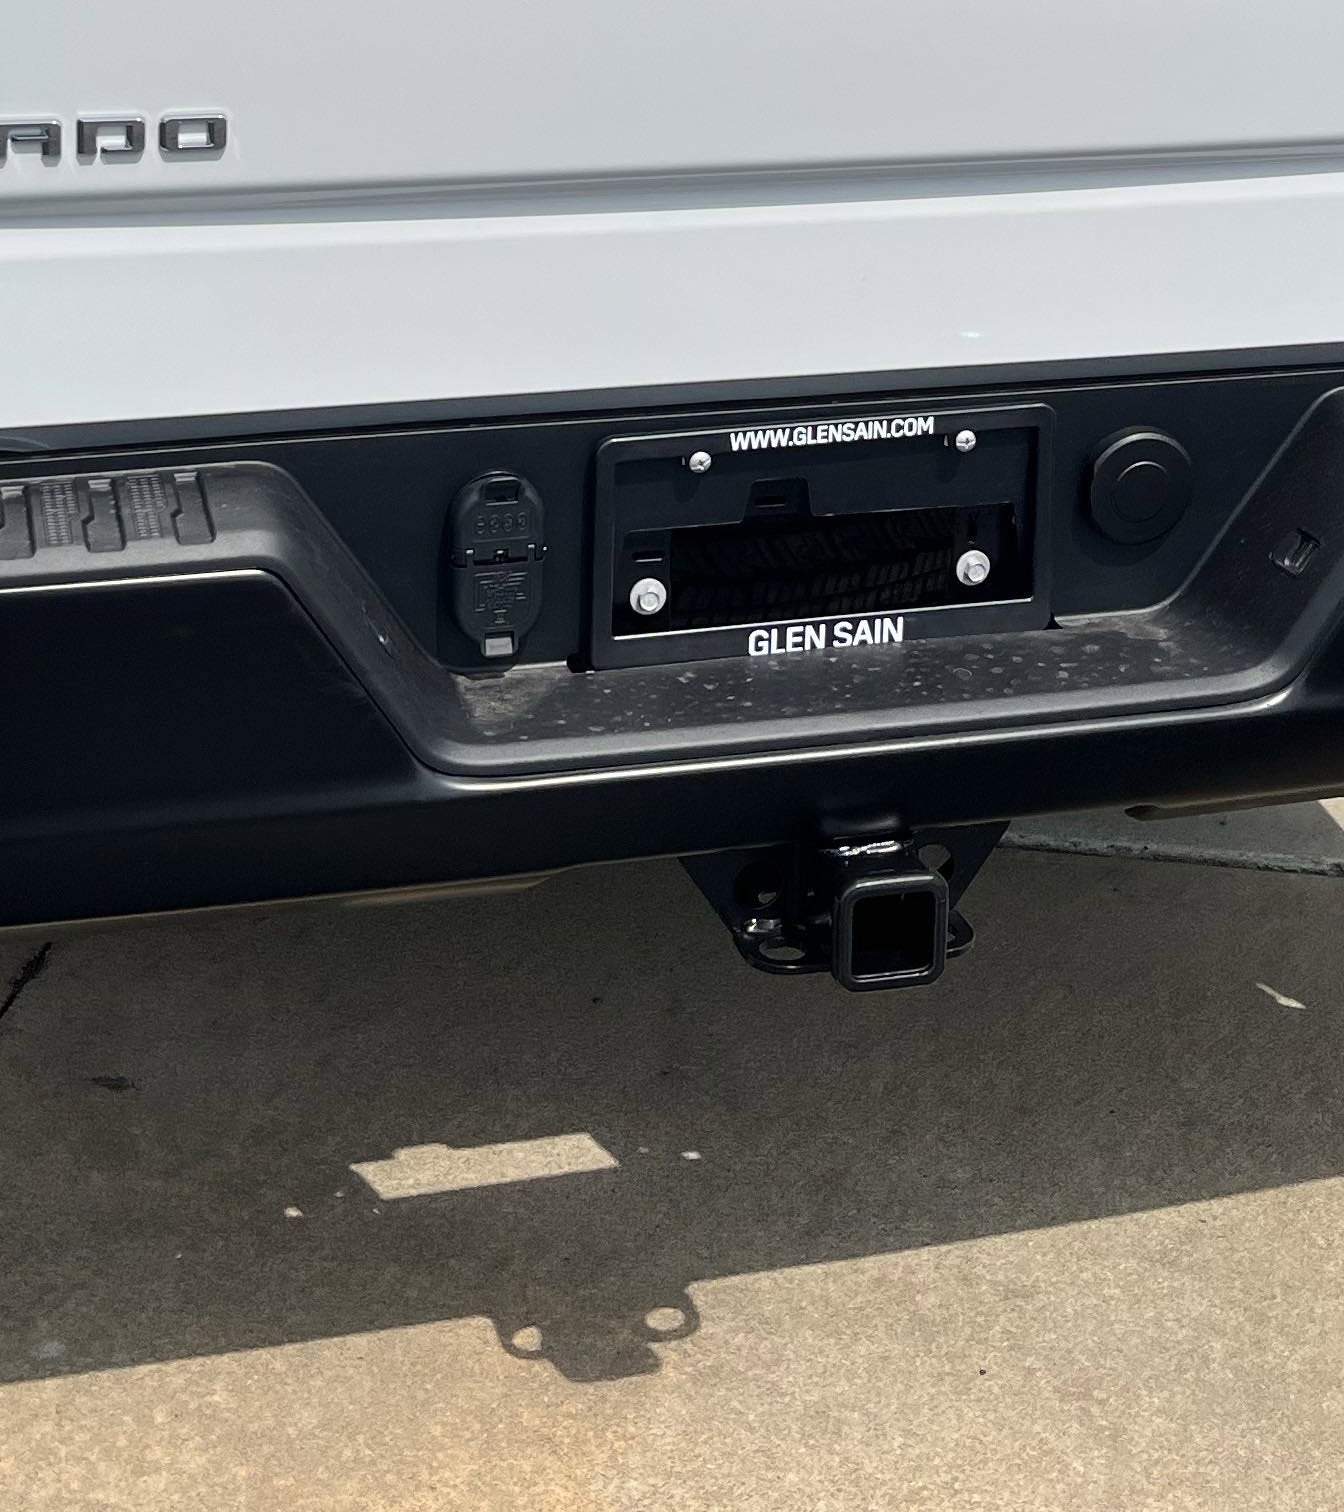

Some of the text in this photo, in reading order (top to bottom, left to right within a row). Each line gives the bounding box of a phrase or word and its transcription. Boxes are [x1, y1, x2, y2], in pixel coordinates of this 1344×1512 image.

[729, 416, 935, 451] WWW.GLENSAIN.COM
[748, 616, 904, 656] GLEN SAIN
